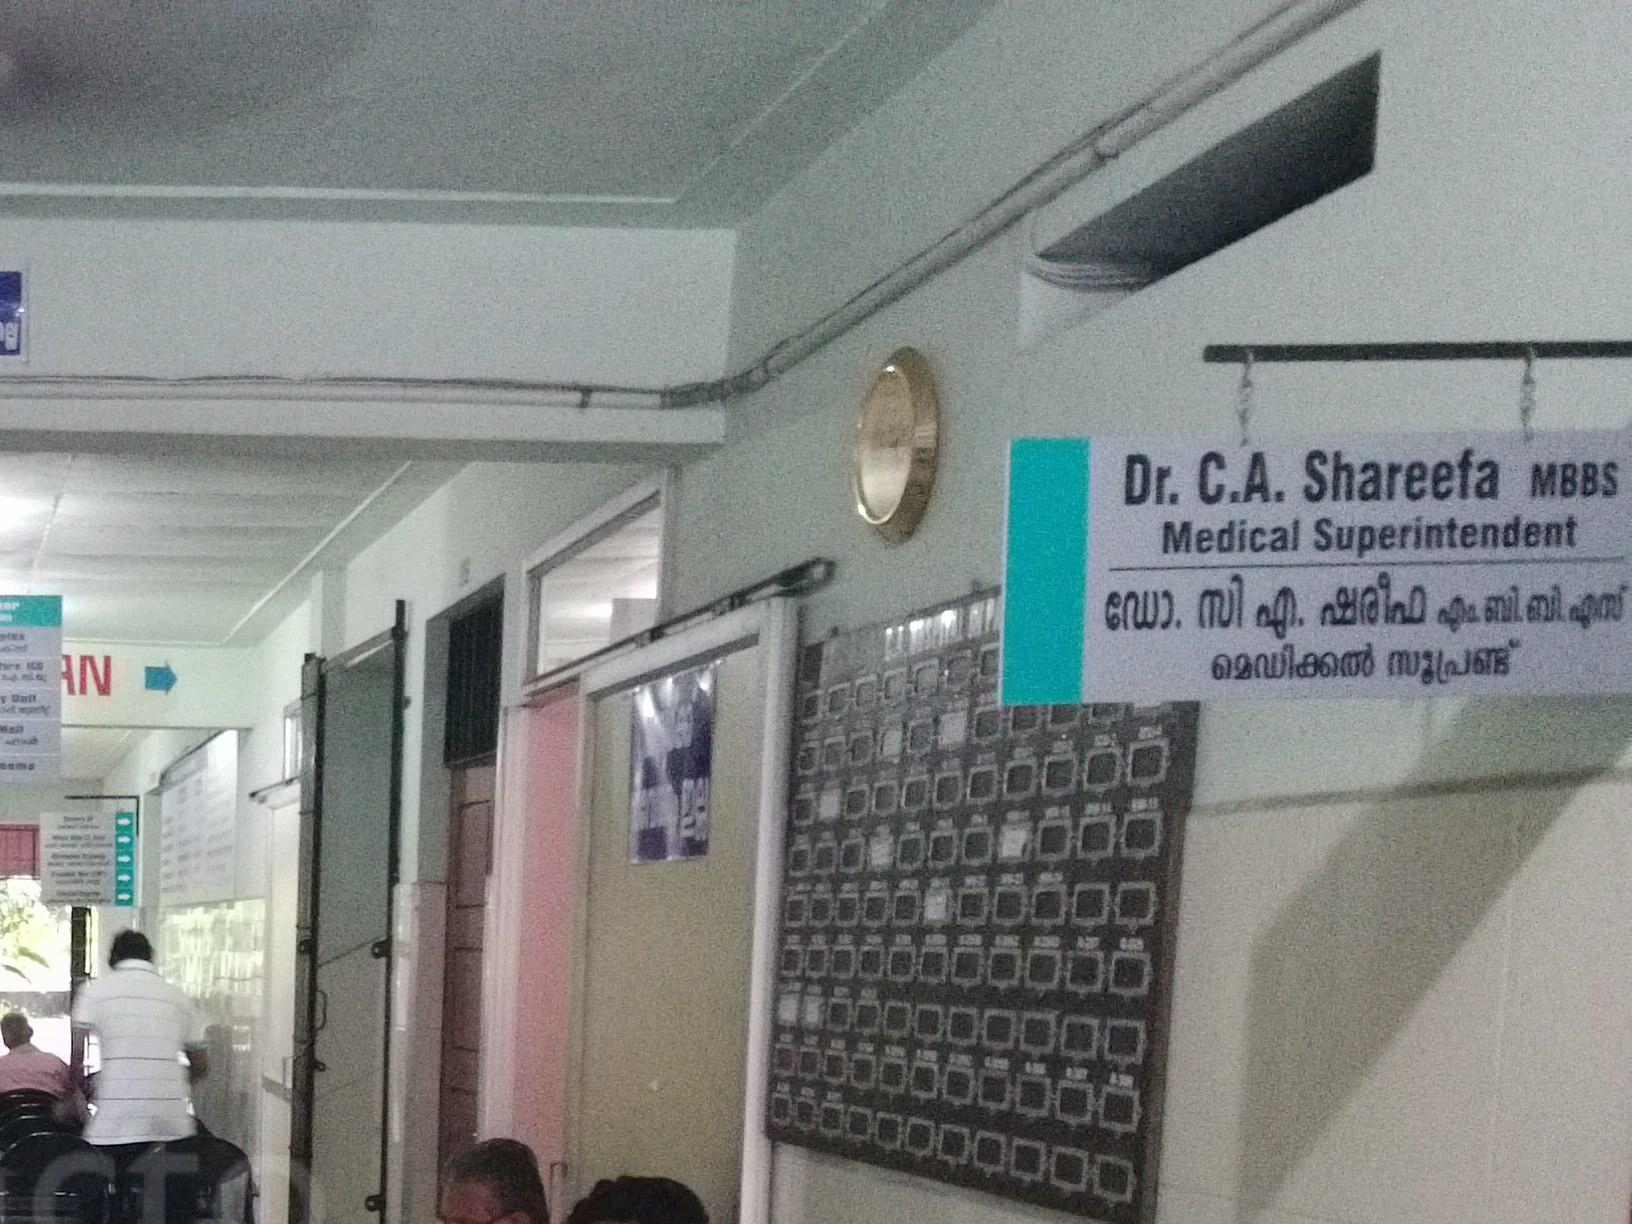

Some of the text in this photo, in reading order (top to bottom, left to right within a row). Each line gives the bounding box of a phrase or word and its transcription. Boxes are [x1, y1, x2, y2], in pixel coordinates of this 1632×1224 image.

[1124, 447, 1618, 506] Dr. C.A. Shareefa MBBS
[1162, 514, 1578, 559] Medical Superintendent
